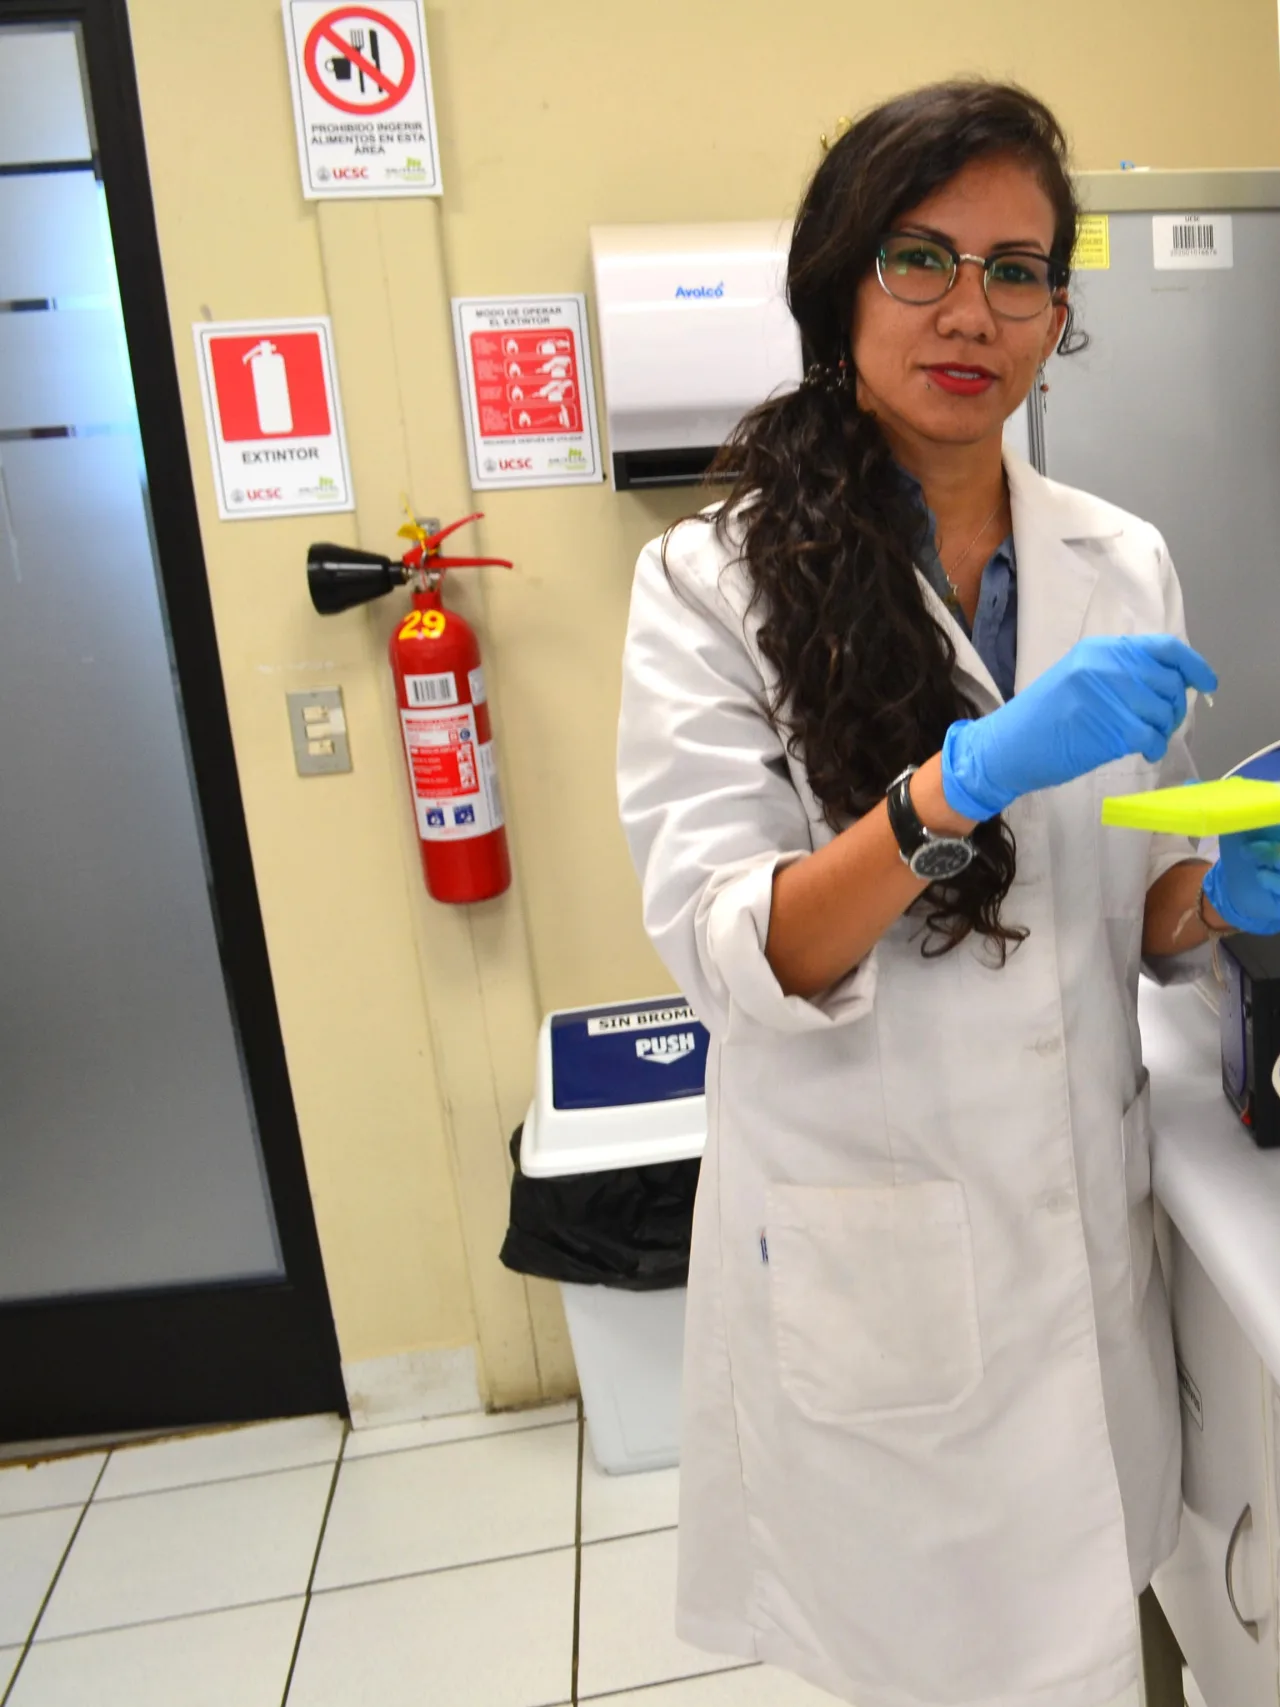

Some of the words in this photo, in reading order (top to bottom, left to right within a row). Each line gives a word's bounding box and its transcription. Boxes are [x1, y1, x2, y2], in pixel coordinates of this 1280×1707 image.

[311, 123, 373, 133] PROHIBIDO
[377, 121, 422, 131] INGERIR
[311, 134, 375, 145] ALIMENTOS
[379, 134, 394, 143] EN
[397, 133, 426, 142] ESTA
[332, 167, 369, 180] UCSC
[475, 308, 505, 318] MODO
[507, 307, 519, 317] DE
[522, 307, 562, 317] OPERAR
[489, 319, 500, 327] EL
[504, 317, 550, 327] EXTINTOR
[242, 447, 319, 465] EXTINTOR
[498, 458, 533, 471] UCSC
[246, 488, 283, 502] UCSC
[398, 610, 446, 640] 29
[599, 1016, 631, 1030] SIN
[635, 1032, 695, 1057] PUSH
